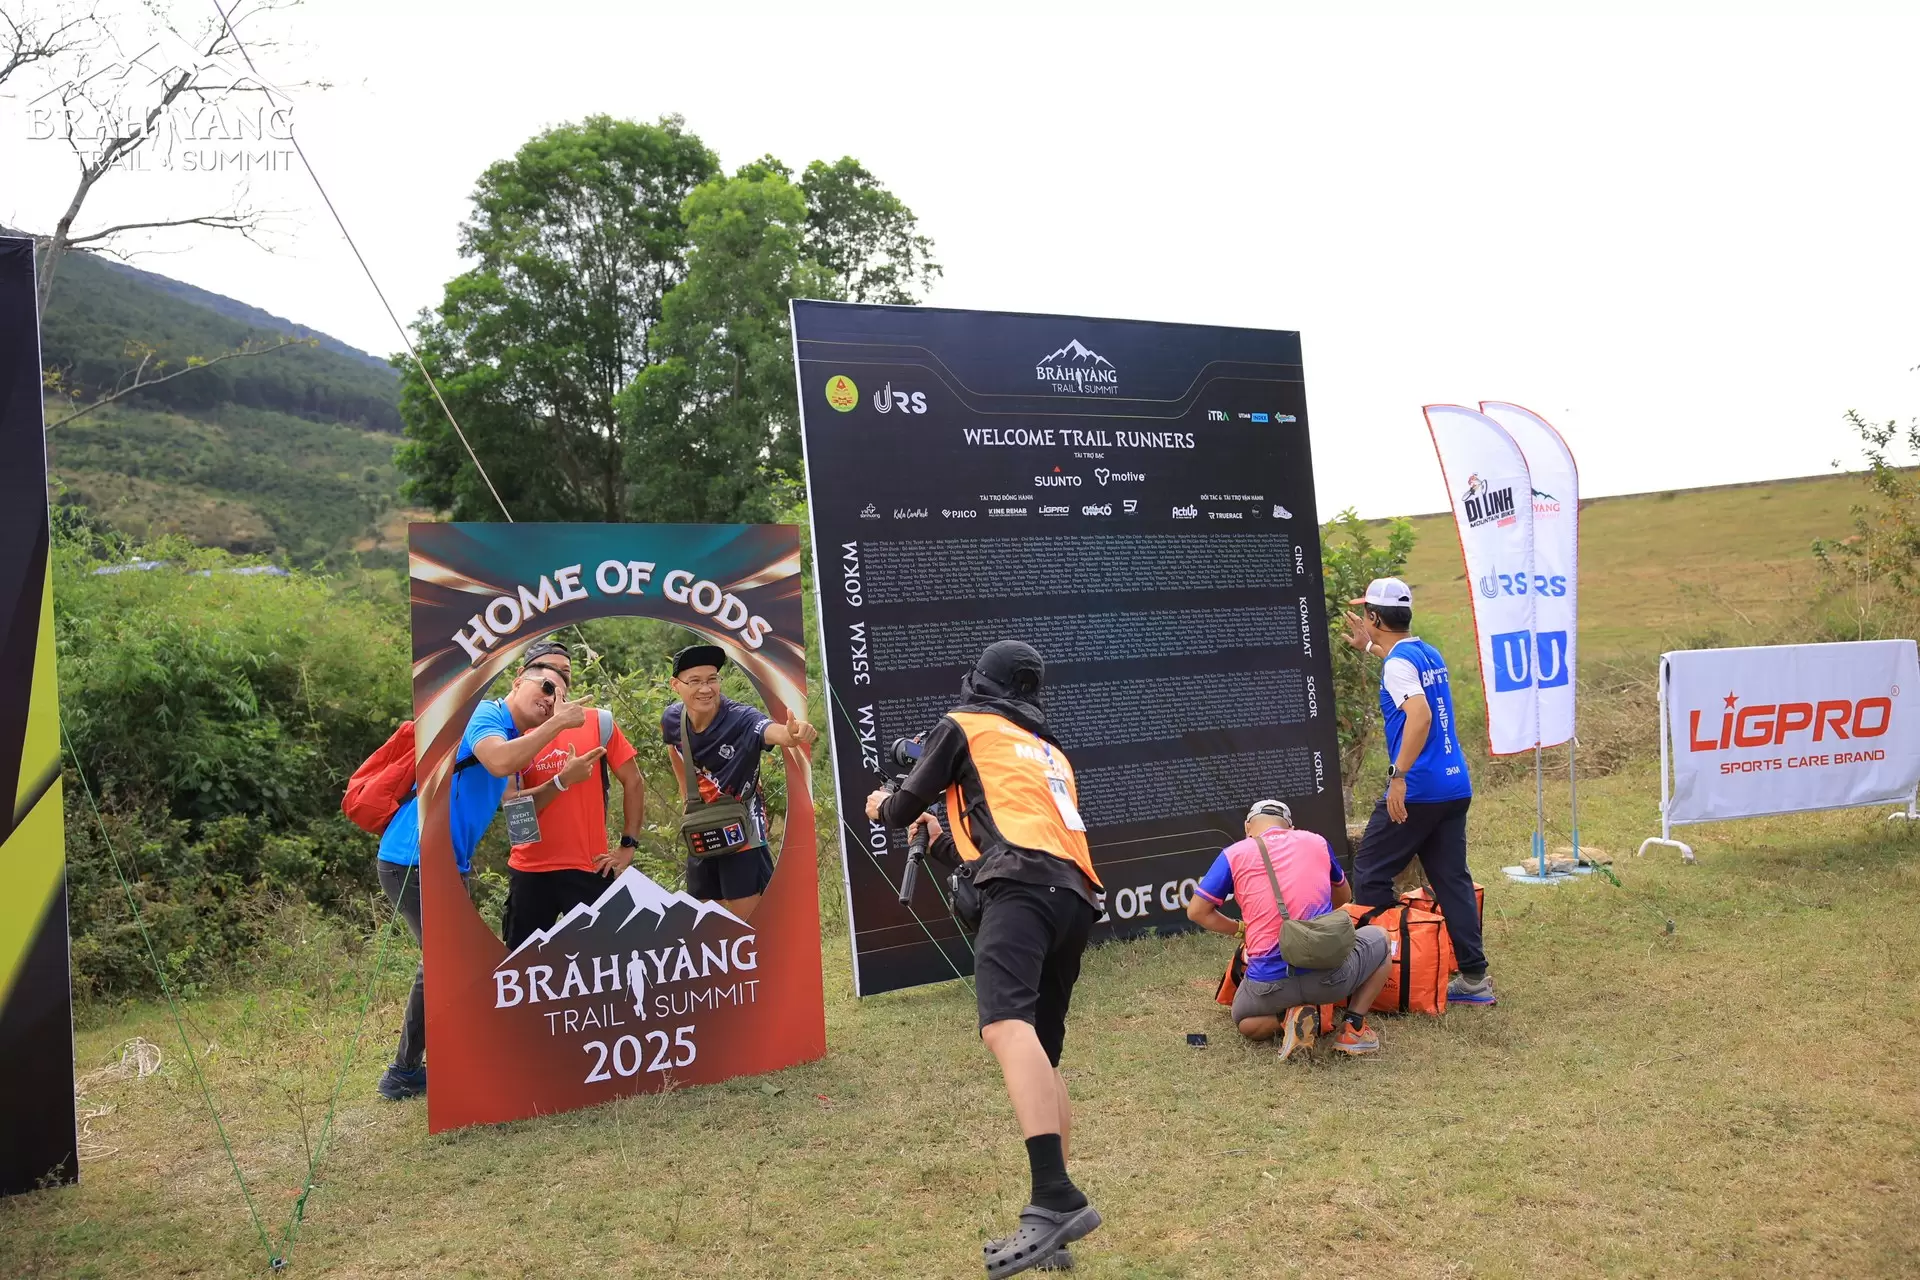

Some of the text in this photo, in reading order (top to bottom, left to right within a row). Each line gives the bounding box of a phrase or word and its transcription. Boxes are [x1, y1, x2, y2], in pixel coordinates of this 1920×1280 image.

[1036, 365, 1117, 383] BRĂH YÀNG
[1051, 383, 1118, 395] TRAIL SUMMIT
[873, 381, 927, 414] URS
[963, 428, 1195, 449] WELCOME TRAIL RUNNERS
[1034, 476, 1082, 487] SUUNTO
[1111, 471, 1145, 482] motive
[952, 510, 977, 519] PJICO
[1464, 497, 1483, 523] DI
[1483, 486, 1514, 516] LINH
[1470, 514, 1500, 529] MOUNTAIN
[1501, 509, 1515, 518] BIKE
[841, 540, 863, 607] 60KM
[1294, 545, 1304, 575] CING
[1479, 564, 1527, 598] URS
[1534, 574, 1567, 598] RS
[450, 559, 774, 668] HOME OF GODS
[850, 621, 871, 686] 35KM
[857, 703, 881, 771] 27KM
[1720, 750, 1885, 775] SPORTS CARE BRAND
[510, 817, 535, 825] PARTNER
[512, 811, 530, 819] EVENT
[869, 820, 888, 858] 10K
[1115, 883, 1153, 919] OF
[492, 934, 758, 1009] BRĂH YÀNG
[543, 979, 760, 1036] TRAIL SUMMIT
[582, 1024, 697, 1084] 2025
